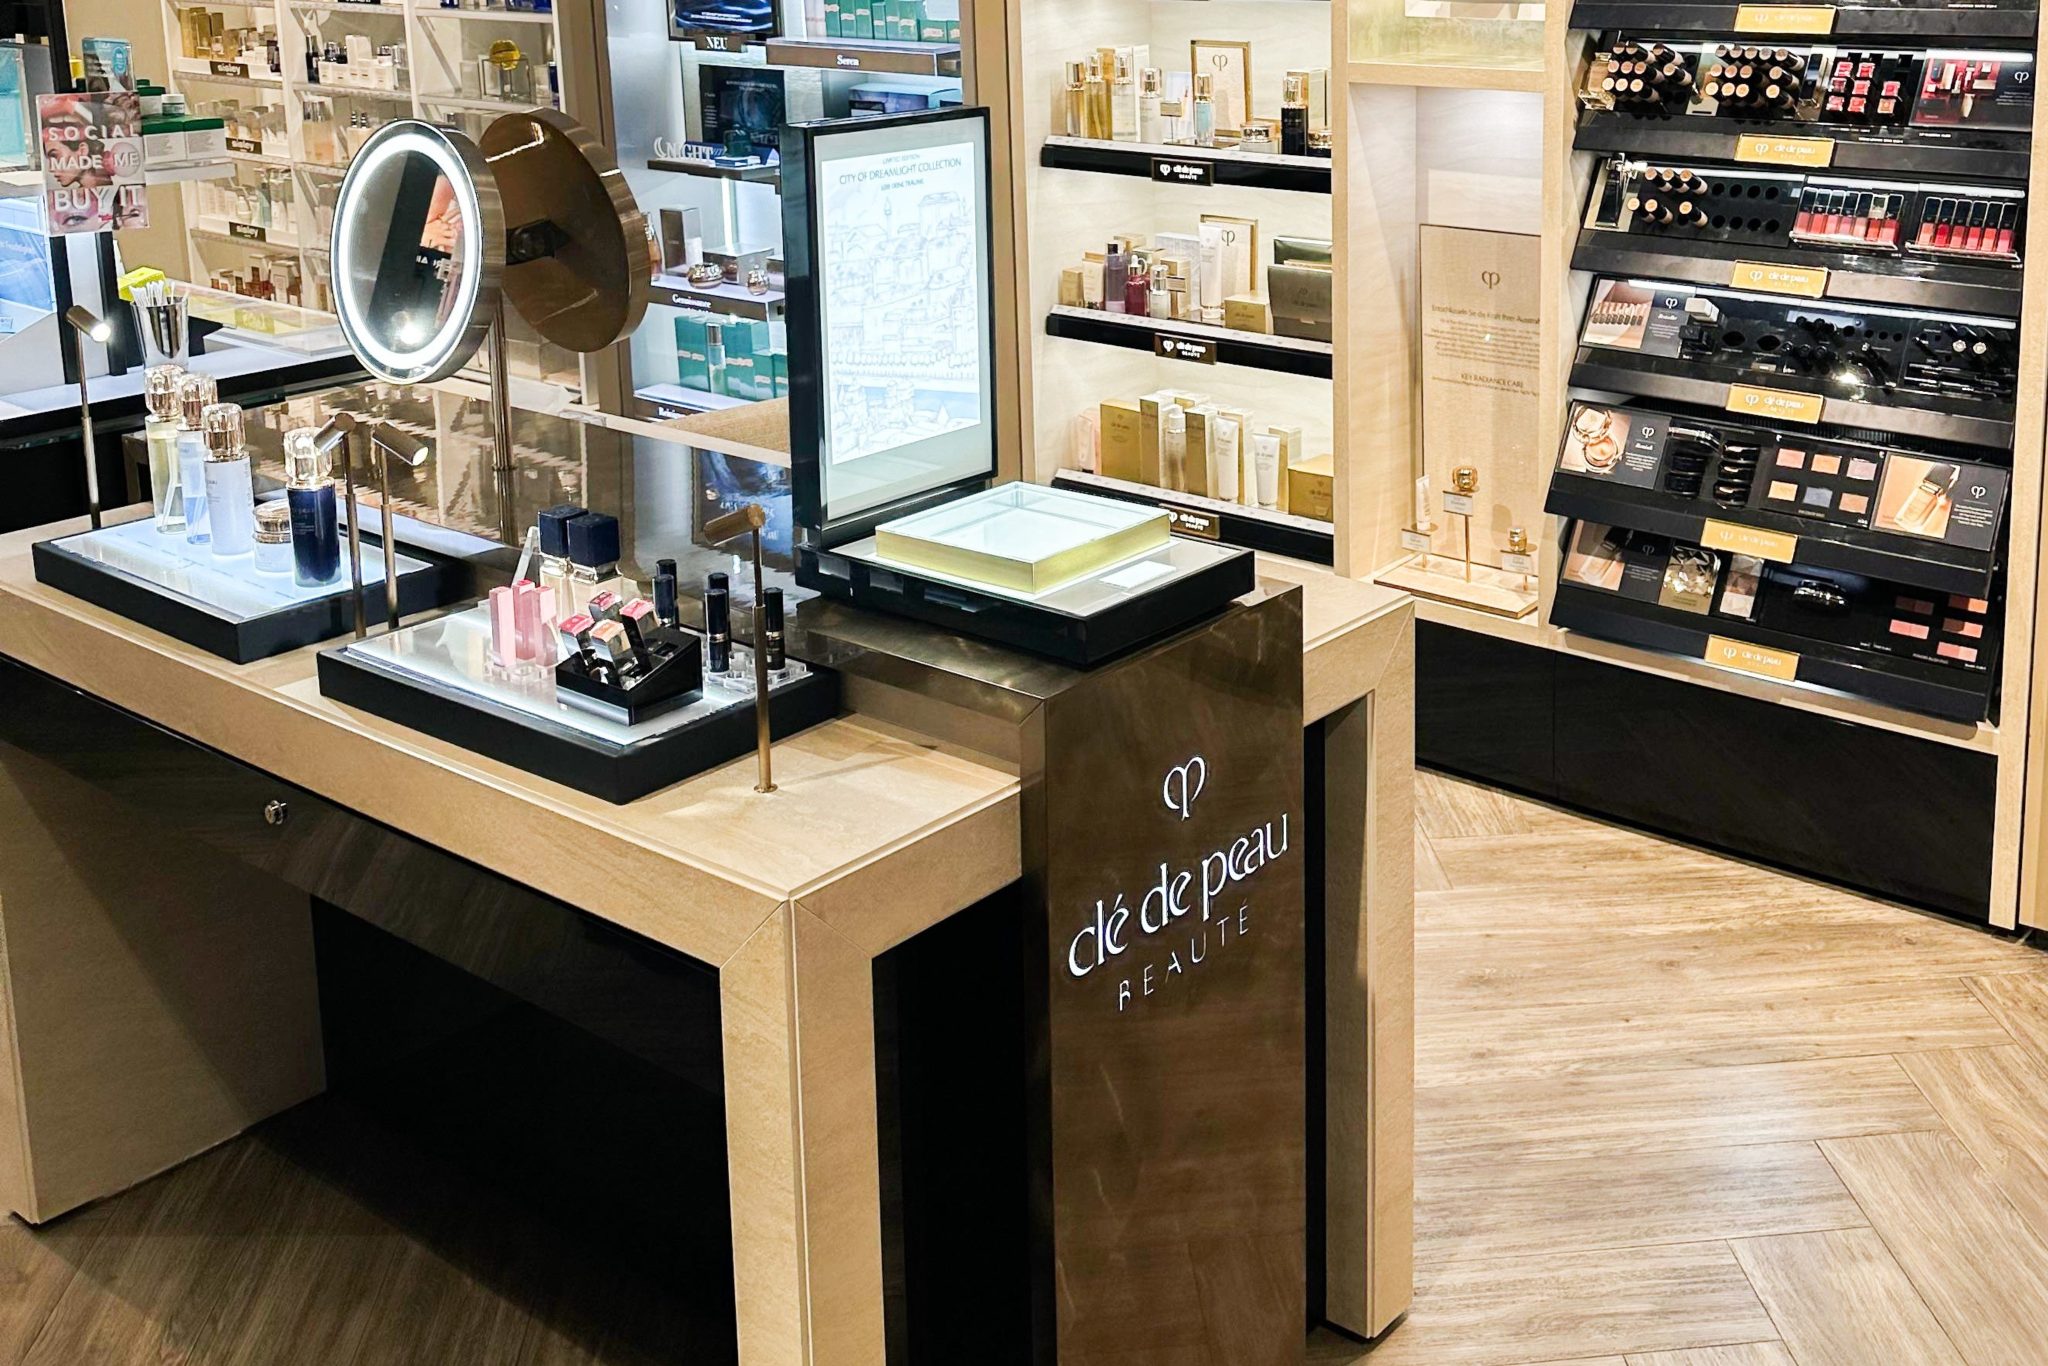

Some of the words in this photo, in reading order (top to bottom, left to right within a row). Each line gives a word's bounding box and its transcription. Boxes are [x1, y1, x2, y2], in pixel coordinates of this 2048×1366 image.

[705, 36, 728, 50] NEU
[48, 124, 140, 142] SOCIAL
[50, 154, 103, 171] MADE
[112, 150, 140, 168] ME
[665, 141, 714, 160] NIGHT
[839, 173, 856, 185] CITY
[857, 171, 868, 182] OF
[869, 163, 917, 180] DREAMLIGHT
[917, 157, 962, 172] COLLECTION
[54, 186, 108, 213] BUY
[119, 185, 141, 208] IT
[1140, 862, 1193, 935] de
[1201, 812, 1289, 923] peau
[1118, 897, 1250, 1012] BEAUTÉ
